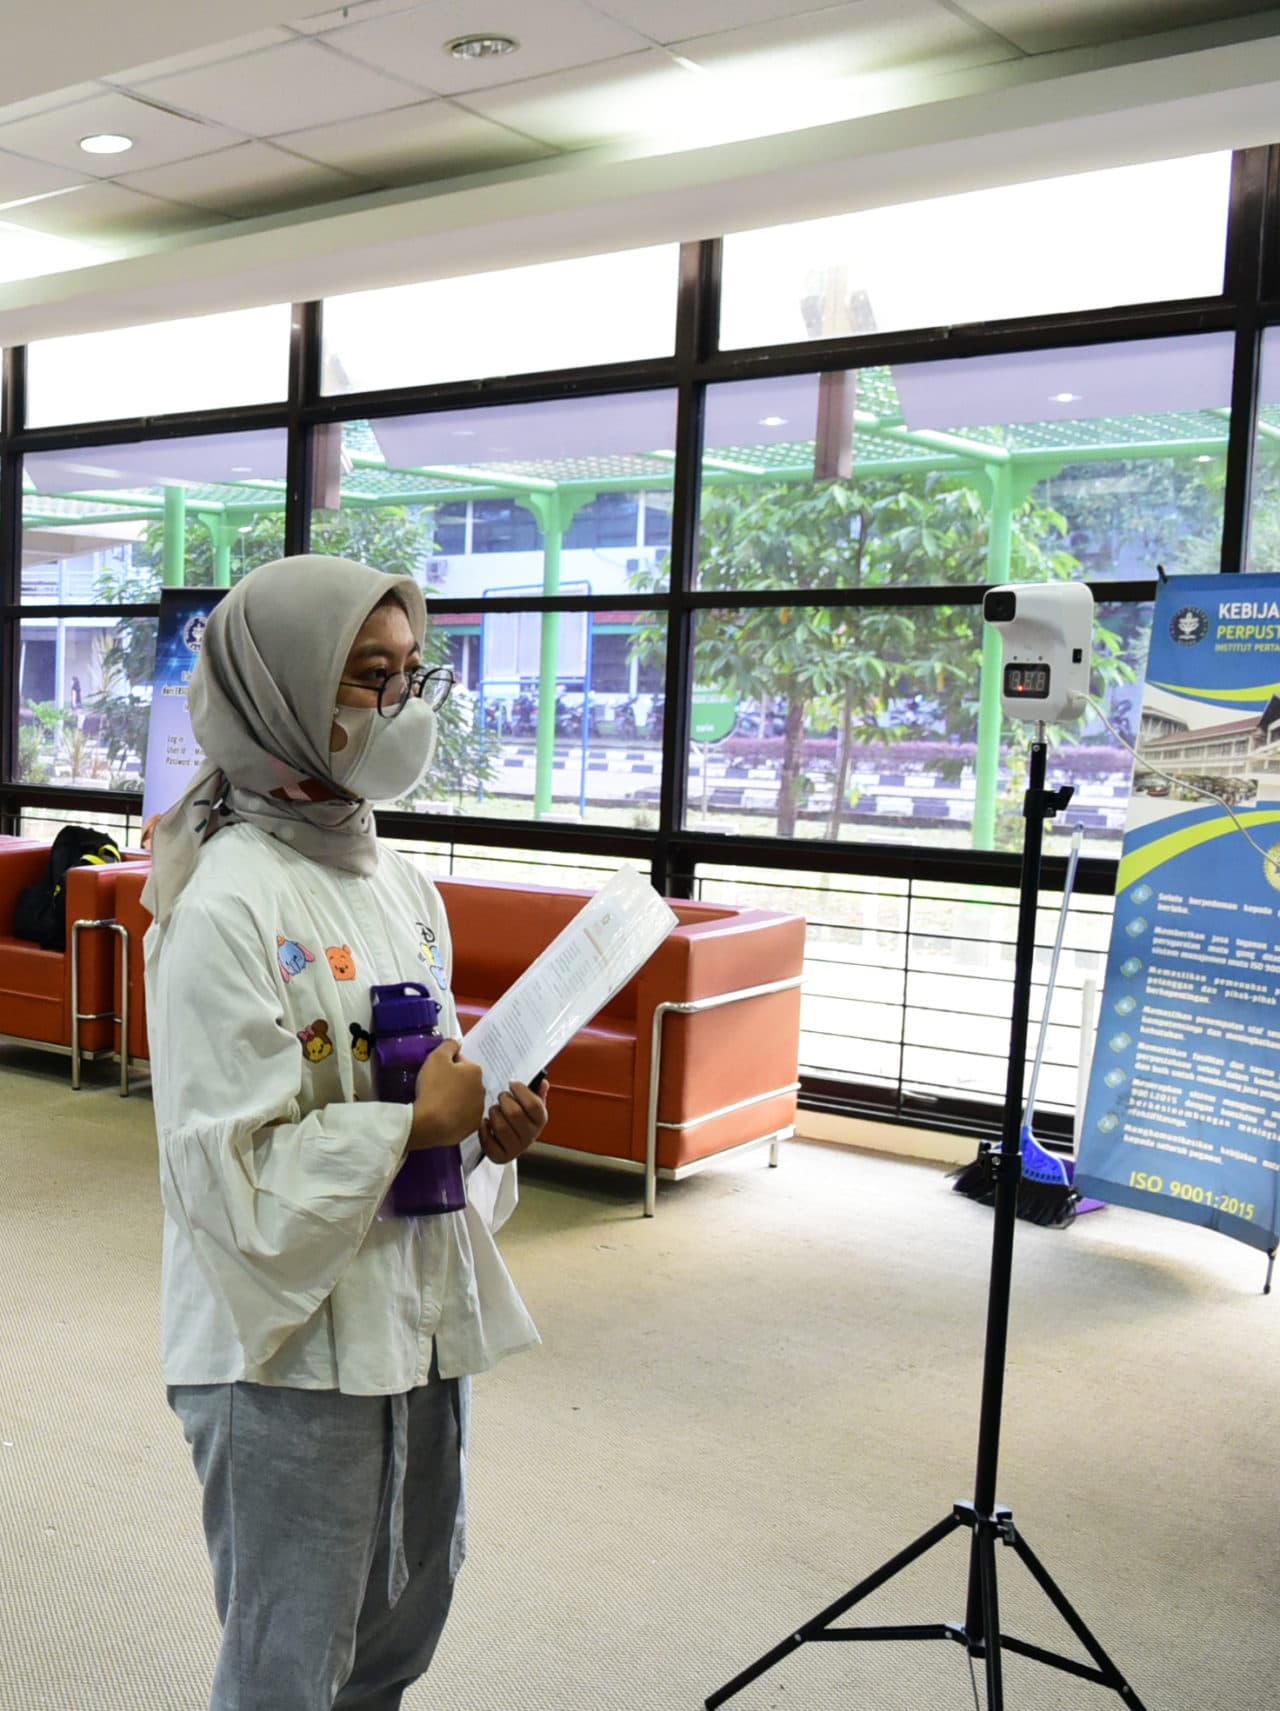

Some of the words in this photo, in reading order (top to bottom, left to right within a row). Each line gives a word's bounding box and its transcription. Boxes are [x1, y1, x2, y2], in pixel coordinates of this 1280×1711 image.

[1218, 602, 1280, 620] KEBIJA
[1129, 1170, 1163, 1193] ISO
[1170, 1182, 1256, 1222] 9001:2015
